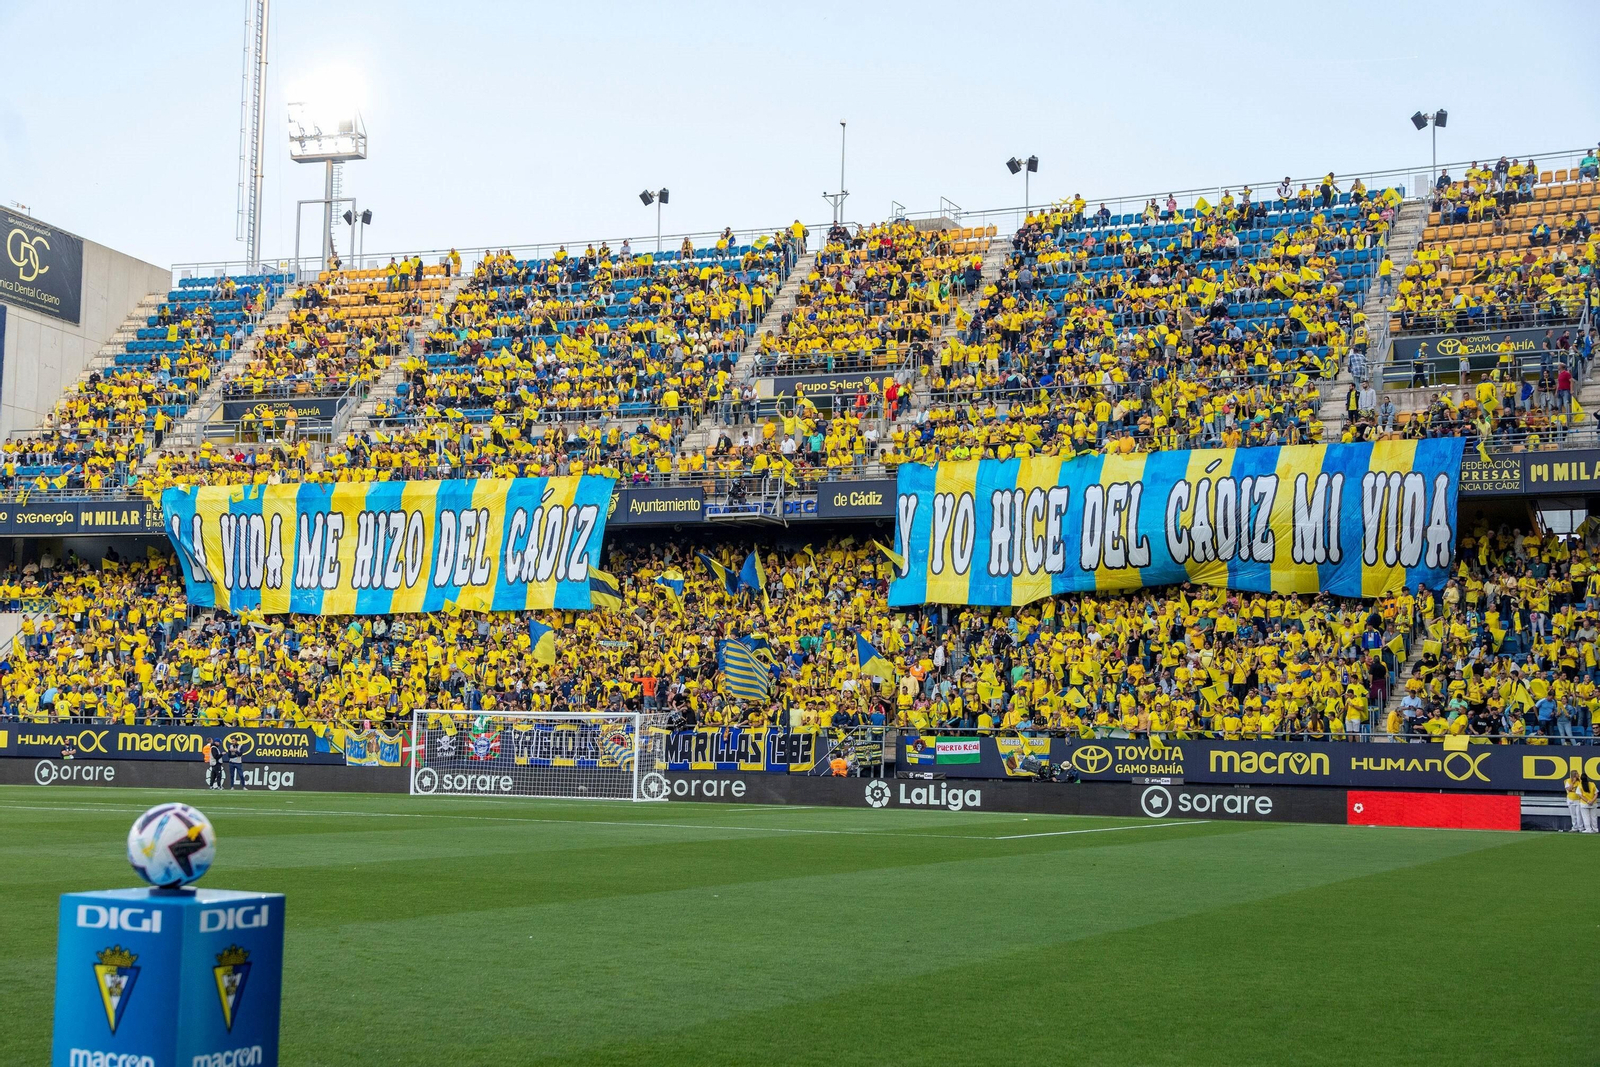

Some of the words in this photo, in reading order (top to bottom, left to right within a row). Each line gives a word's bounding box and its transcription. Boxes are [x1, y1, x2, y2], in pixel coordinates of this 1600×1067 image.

[15, 282, 36, 298] Dental
[36, 289, 60, 306] Copano
[1466, 335, 1491, 343] TOYOTA
[1466, 342, 1500, 354] GAMO
[1510, 338, 1536, 351] AHÍA
[298, 406, 320, 416] BAHÍA
[1461, 458, 1520, 470] FEDERACIÓN
[1483, 482, 1493, 490] DE
[1495, 480, 1520, 490] CÁDIZ
[629, 498, 701, 515] Ayuntamiento
[833, 492, 848, 506] de
[850, 491, 883, 506] Cádiz
[95, 510, 140, 526] MILAR
[898, 493, 919, 579] Y
[930, 491, 977, 577] YO
[987, 485, 1069, 578] HICE
[1079, 481, 1150, 571] DEL
[1165, 458, 1279, 565] CÁDIZ
[1291, 472, 1345, 565] MI
[1361, 470, 1452, 569] VIDA
[220, 513, 284, 590] VIDA
[295, 511, 344, 590] ME
[351, 509, 425, 590] HIZO
[433, 507, 492, 588] DEL
[504, 488, 600, 585] CÁDIZ
[118, 732, 203, 752] macron
[256, 733, 309, 747] TOYOTA
[769, 732, 813, 764] 1982
[256, 748, 281, 757] GAMO
[282, 747, 309, 758] BAHÍA
[1115, 745, 1184, 761] TOYOTA
[1115, 764, 1148, 774] GAMO
[1150, 762, 1184, 775] BAHÍA
[1210, 751, 1330, 776] macron
[52, 765, 115, 781] sorare
[233, 765, 294, 790] LaLiga
[442, 774, 513, 791] sorare
[663, 779, 747, 797] sorare
[900, 782, 981, 811] LaLiga
[1178, 792, 1273, 815] sorare
[76, 904, 162, 933] DIGI
[199, 905, 269, 933] DIGI
[69, 1048, 155, 1067] macron
[193, 1045, 262, 1067] macron
